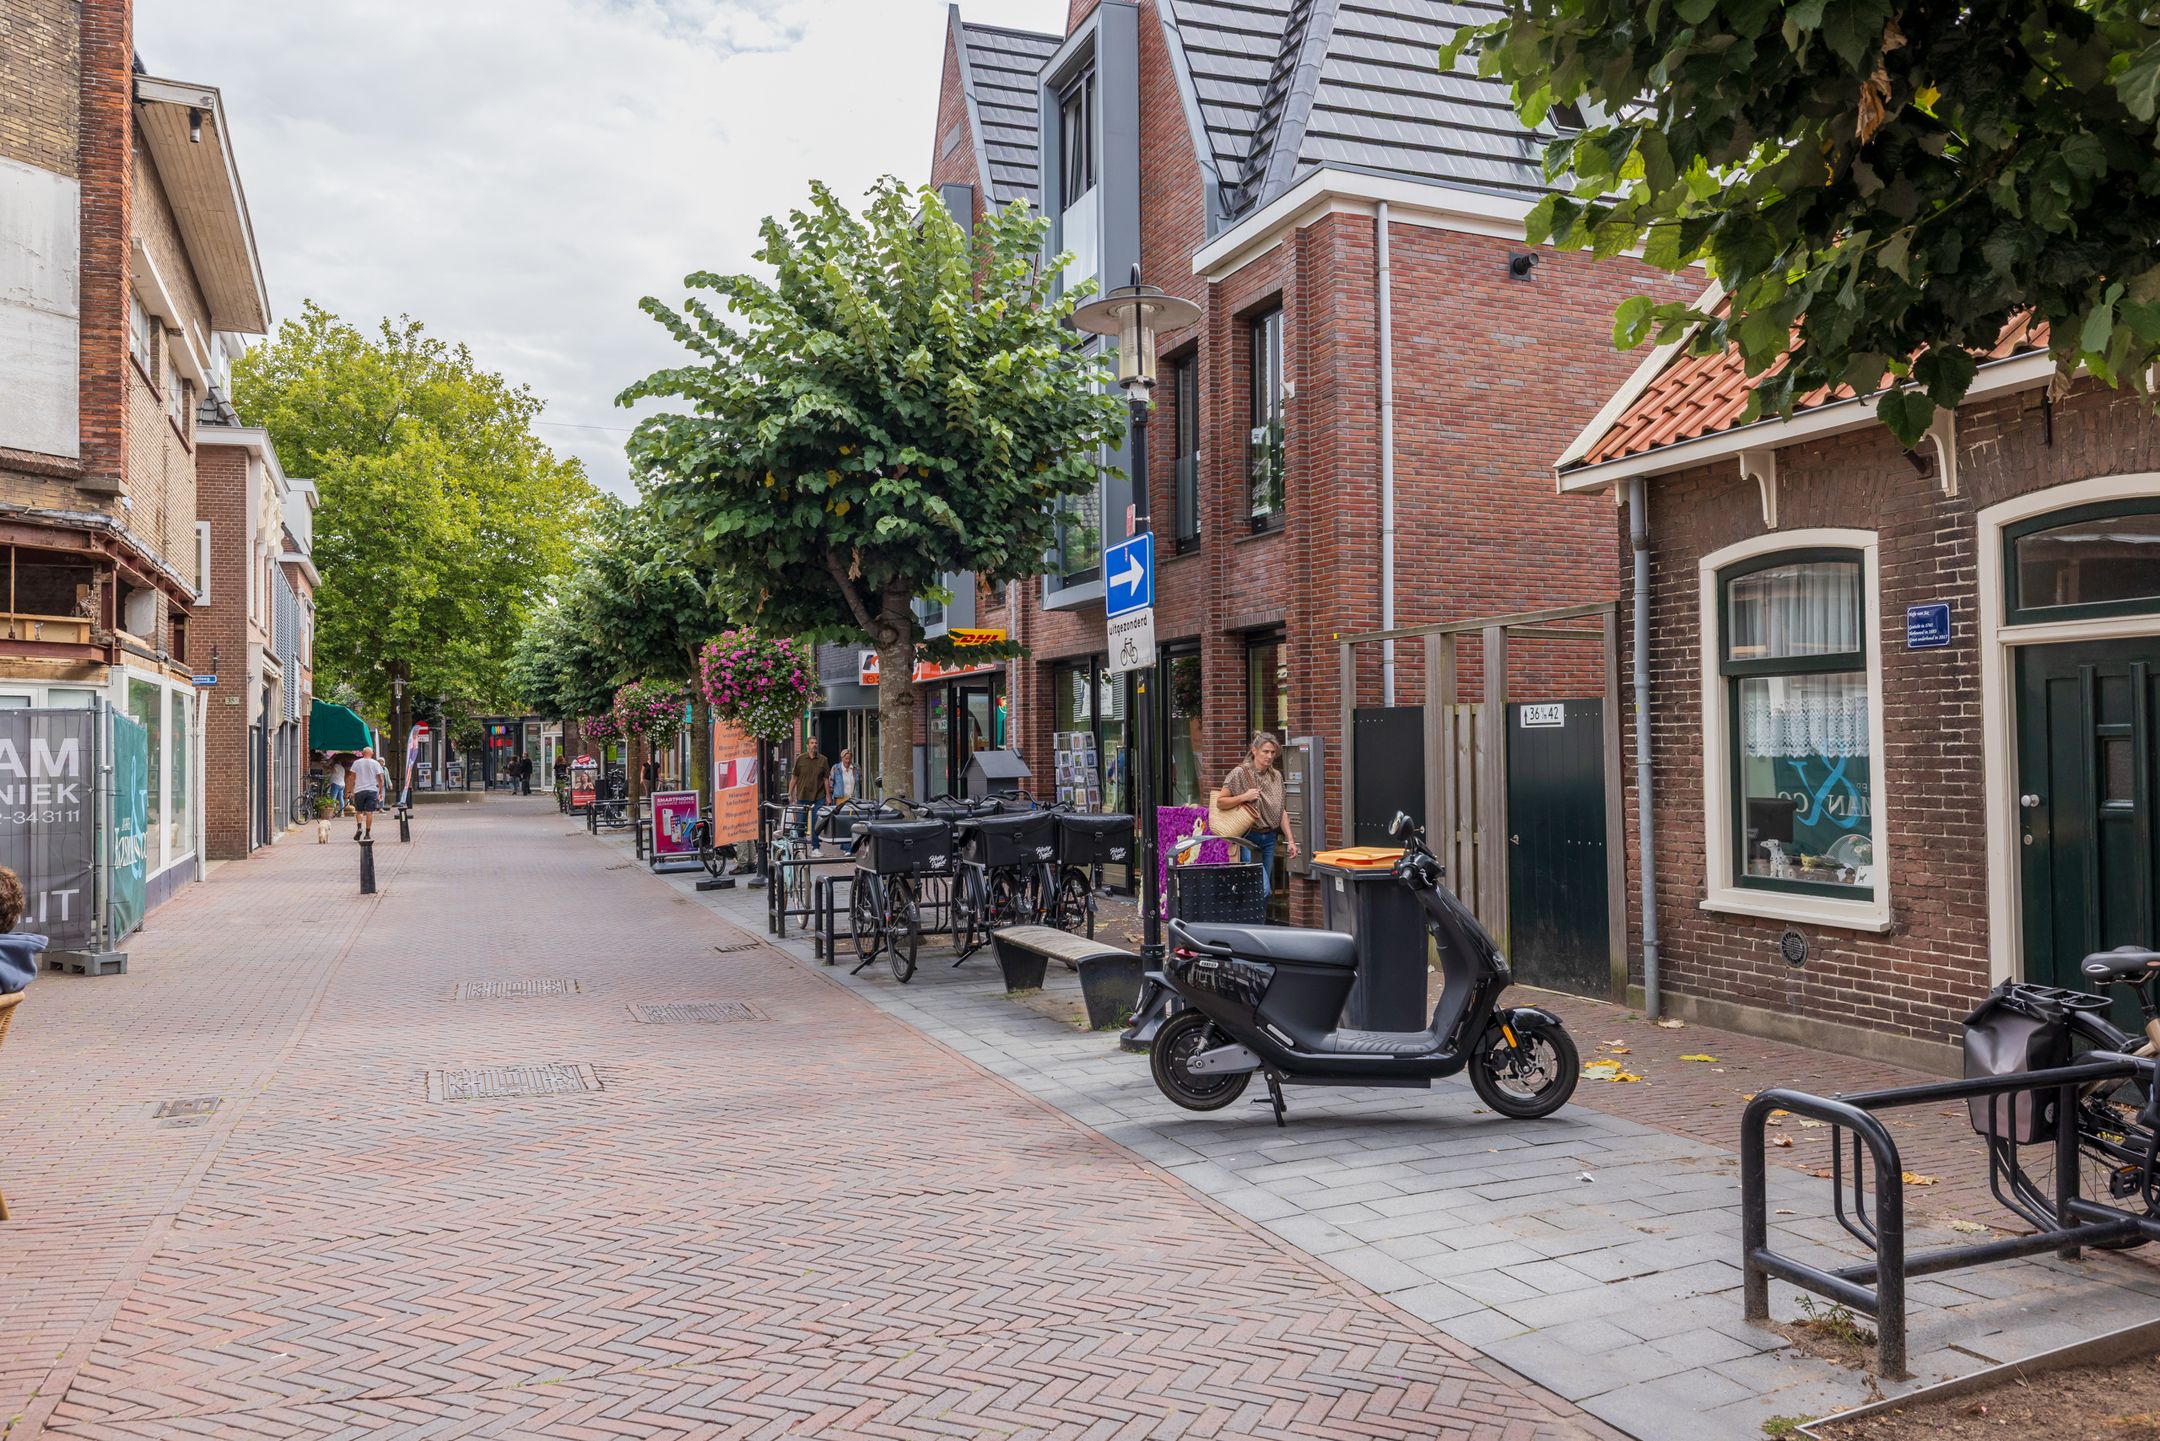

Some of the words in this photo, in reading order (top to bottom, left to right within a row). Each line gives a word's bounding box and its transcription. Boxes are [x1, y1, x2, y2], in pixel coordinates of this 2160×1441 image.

[1108, 615, 1148, 637] uitgezonderd
[1530, 706, 1540, 720] 36
[1548, 706, 1559, 719] 42
[0, 738, 79, 777] AM
[0, 783, 80, 805] NIEK
[17, 889, 80, 923] .IT
